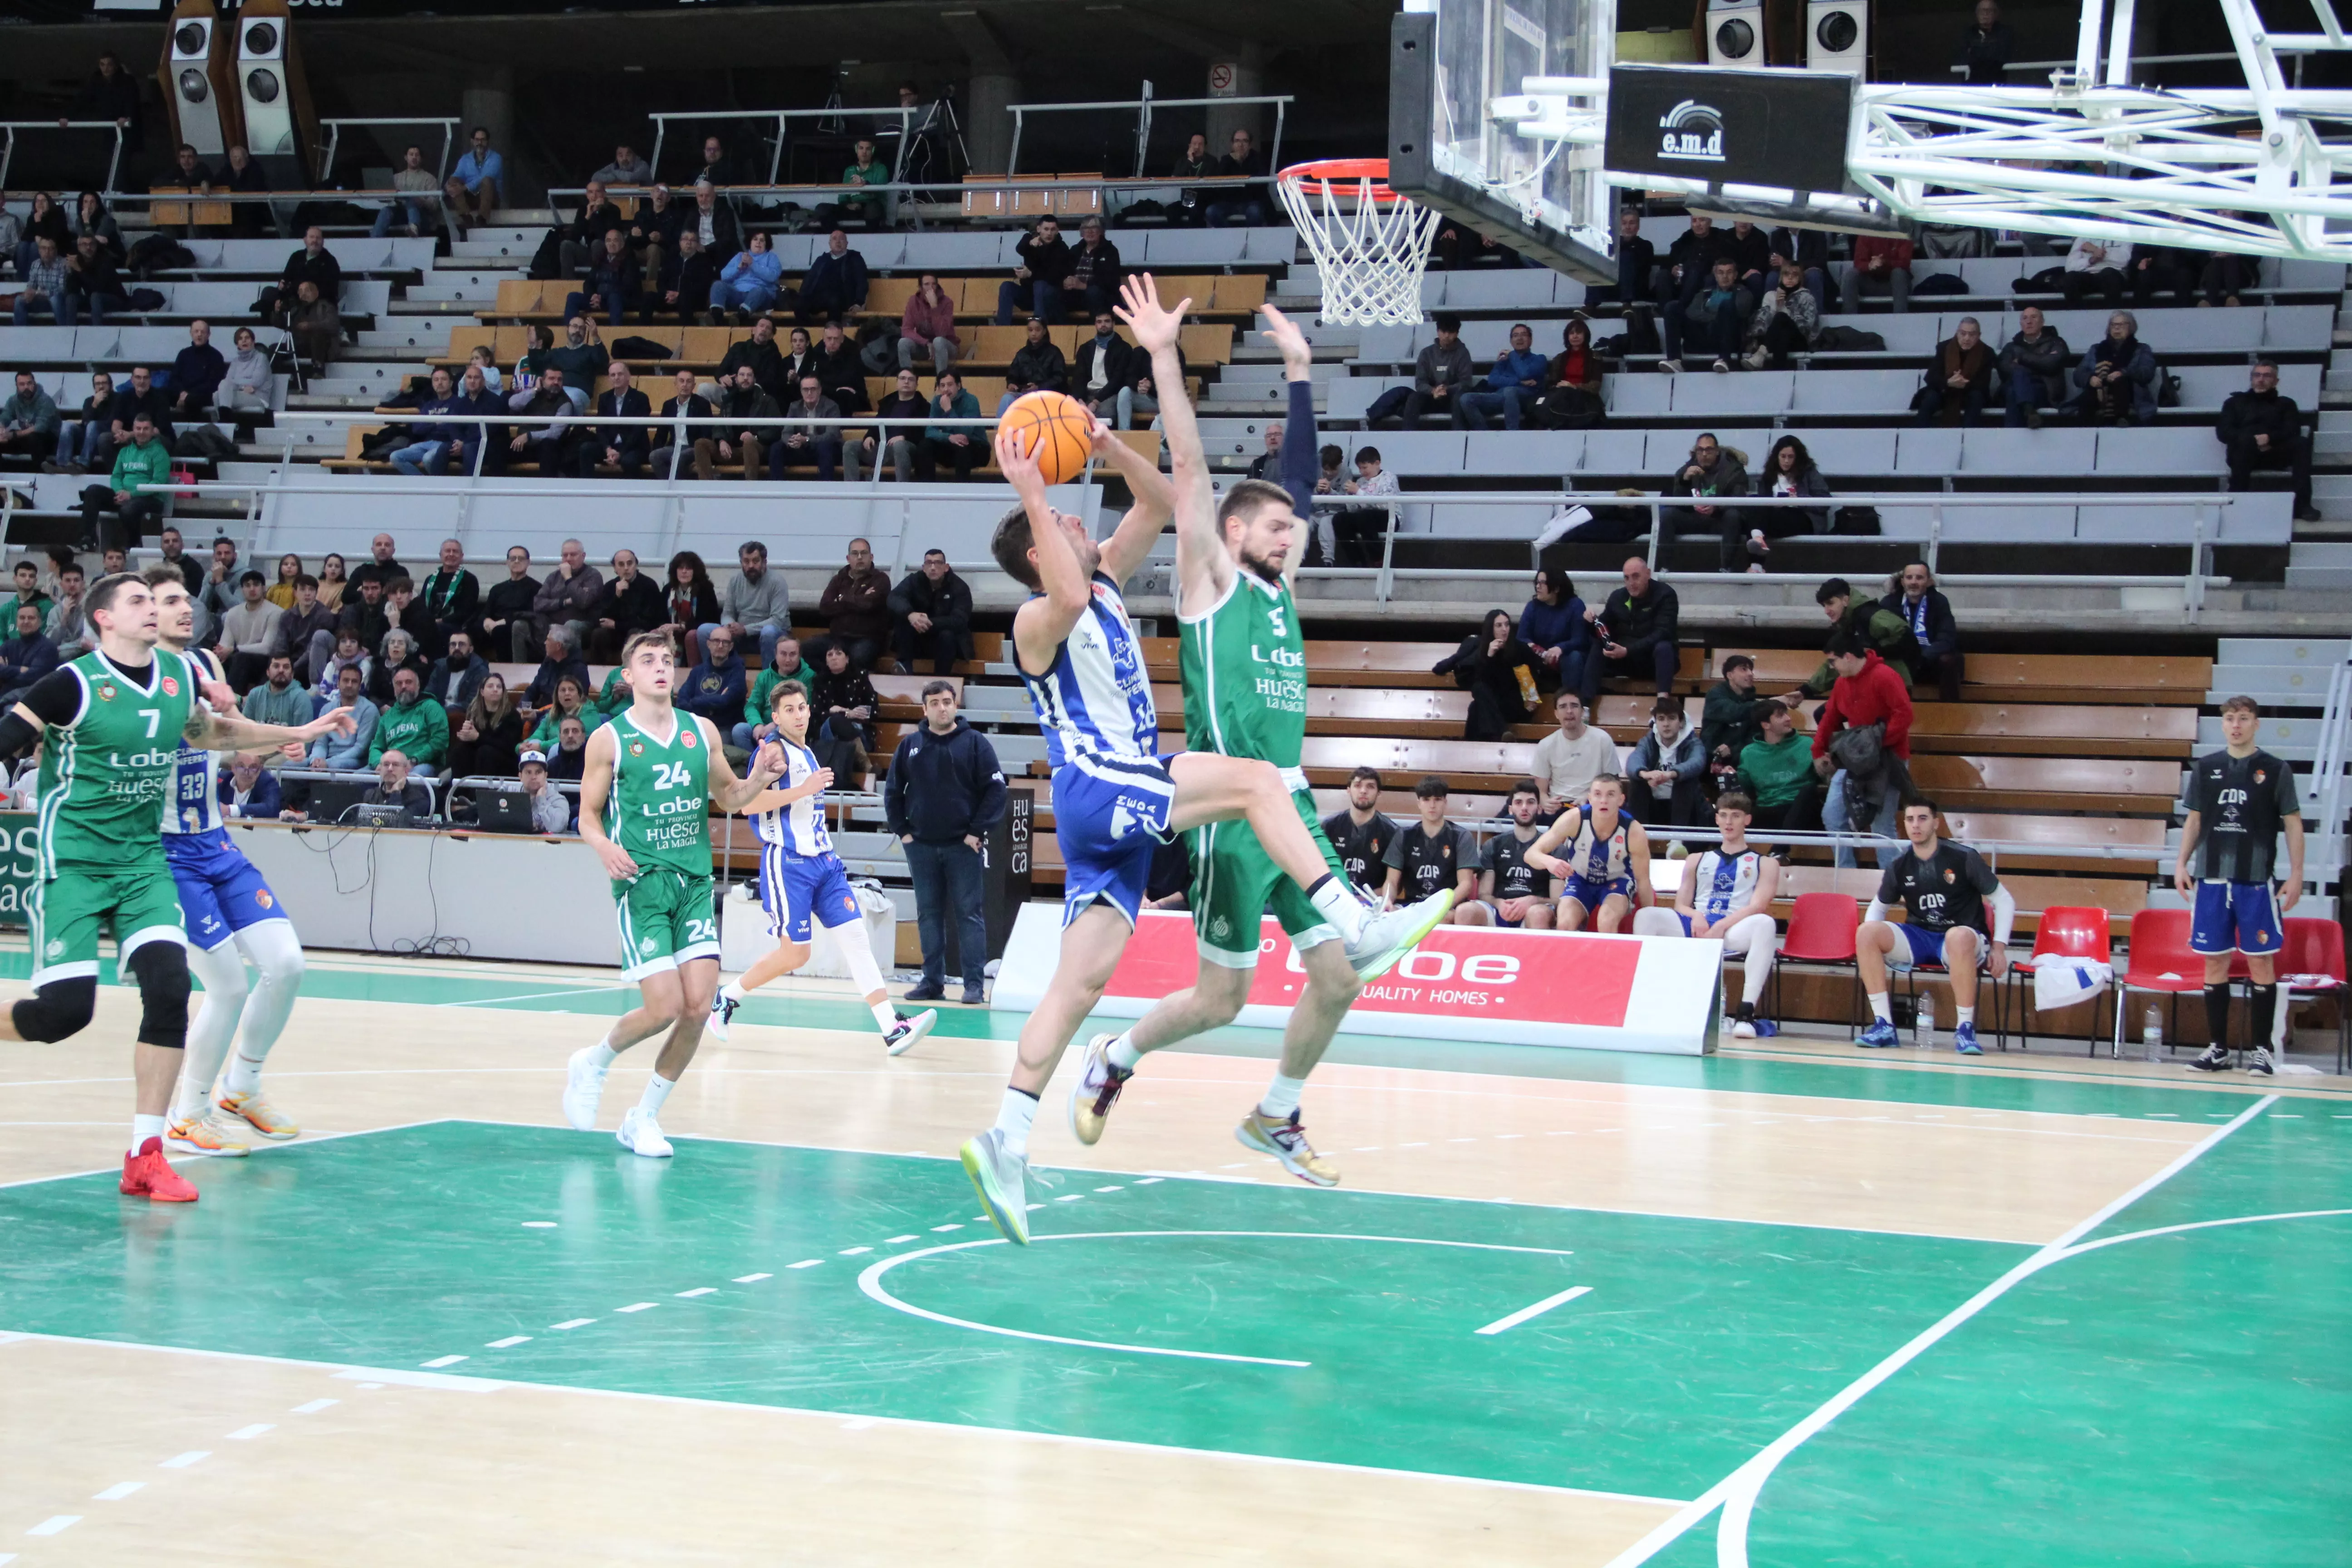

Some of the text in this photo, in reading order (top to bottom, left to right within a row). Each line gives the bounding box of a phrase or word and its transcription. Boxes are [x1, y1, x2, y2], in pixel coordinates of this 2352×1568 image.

[1662, 130, 1721, 155] e.m.d
[1268, 606, 1287, 637] 5
[138, 709, 160, 738] 7
[909, 747, 919, 757] AS
[181, 772, 205, 800] 33
[652, 761, 691, 790] 24
[643, 796, 702, 817] Lobe
[2217, 788, 2248, 805] CDP
[646, 821, 700, 842] Huesca
[1012, 818, 1028, 842] es
[1012, 852, 1027, 873] ca
[1416, 865, 1440, 879] CDP
[1919, 893, 1946, 911] CDP
[686, 918, 717, 943] 24
[1429, 989, 1489, 1005] HOMES
